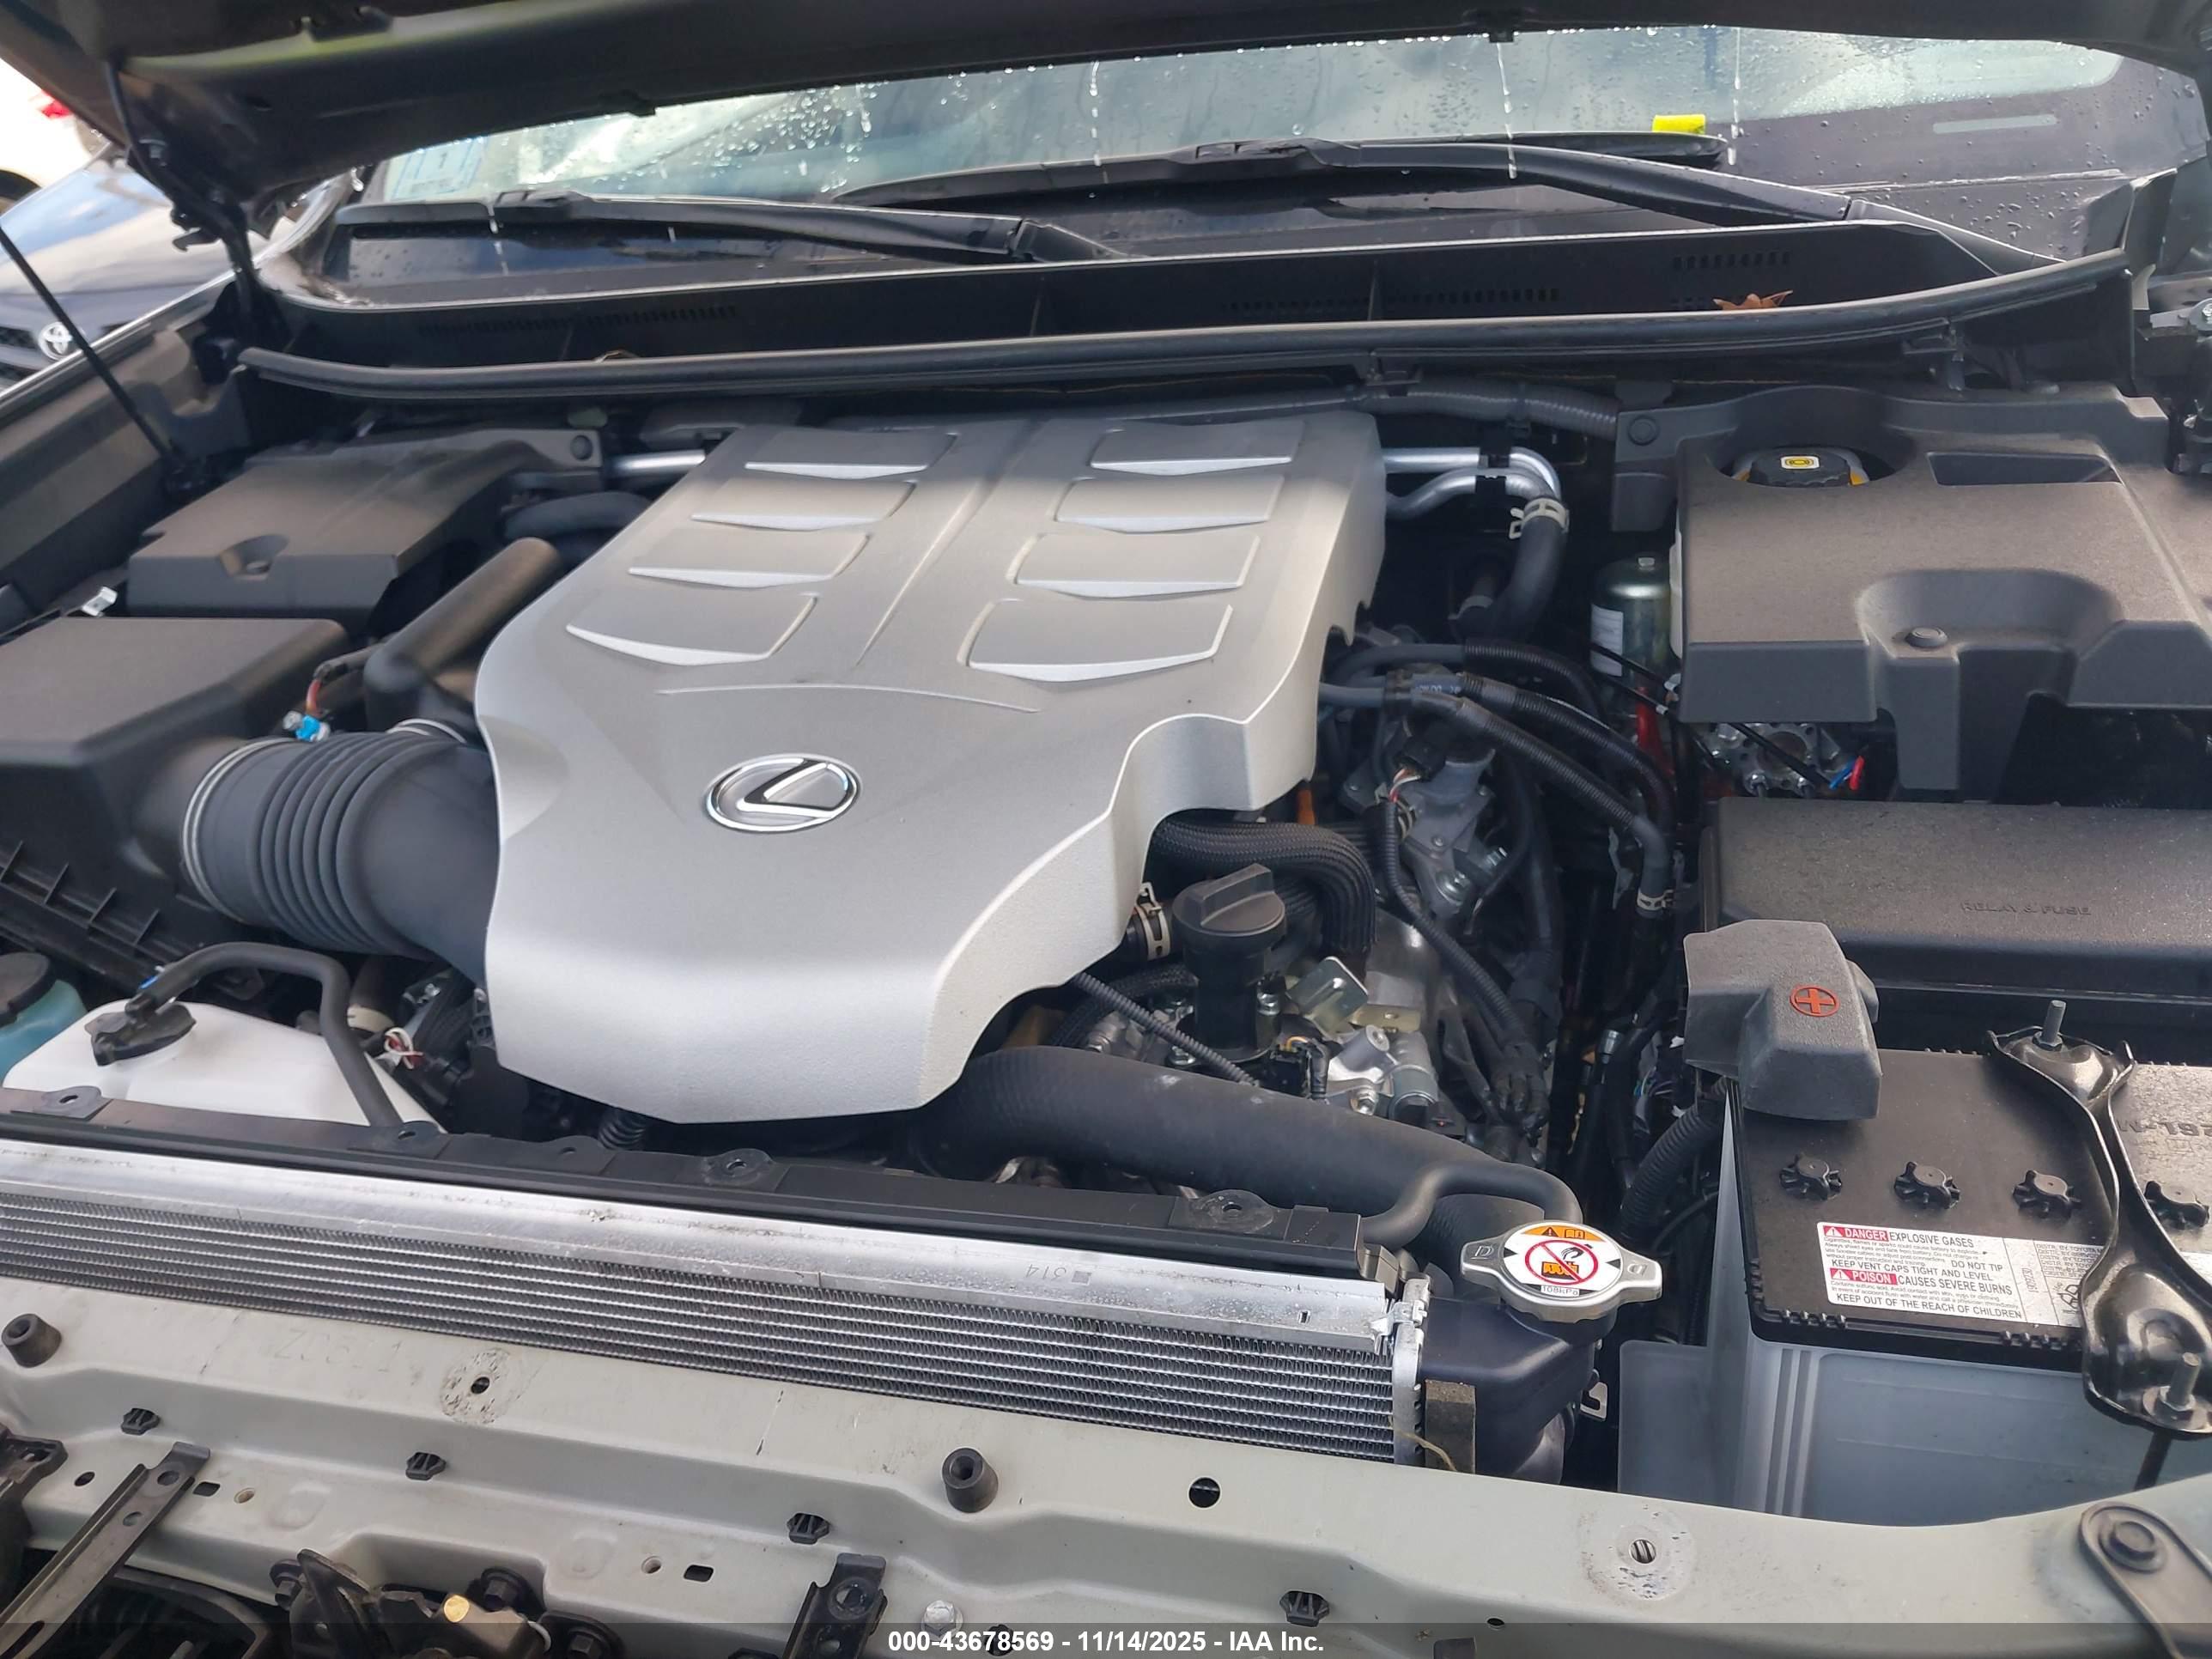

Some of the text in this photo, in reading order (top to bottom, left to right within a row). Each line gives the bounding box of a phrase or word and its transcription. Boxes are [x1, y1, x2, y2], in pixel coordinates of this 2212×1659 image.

[1845, 1227, 1974, 1248] DANGER EXPLOSIVE GASES
[1832, 1259, 1993, 1281] KEEP VENT CAPS TIGHT AND LEVEL
[1951, 1260, 2003, 1272] DO NOT TIP
[1542, 1285, 1579, 1297] 108kPa
[1852, 1272, 2013, 1296] POISON CAUSES SEVERE BURNS
[1837, 1293, 2022, 1319] KEEP OUT OF THE REACH OF CHILDREN
